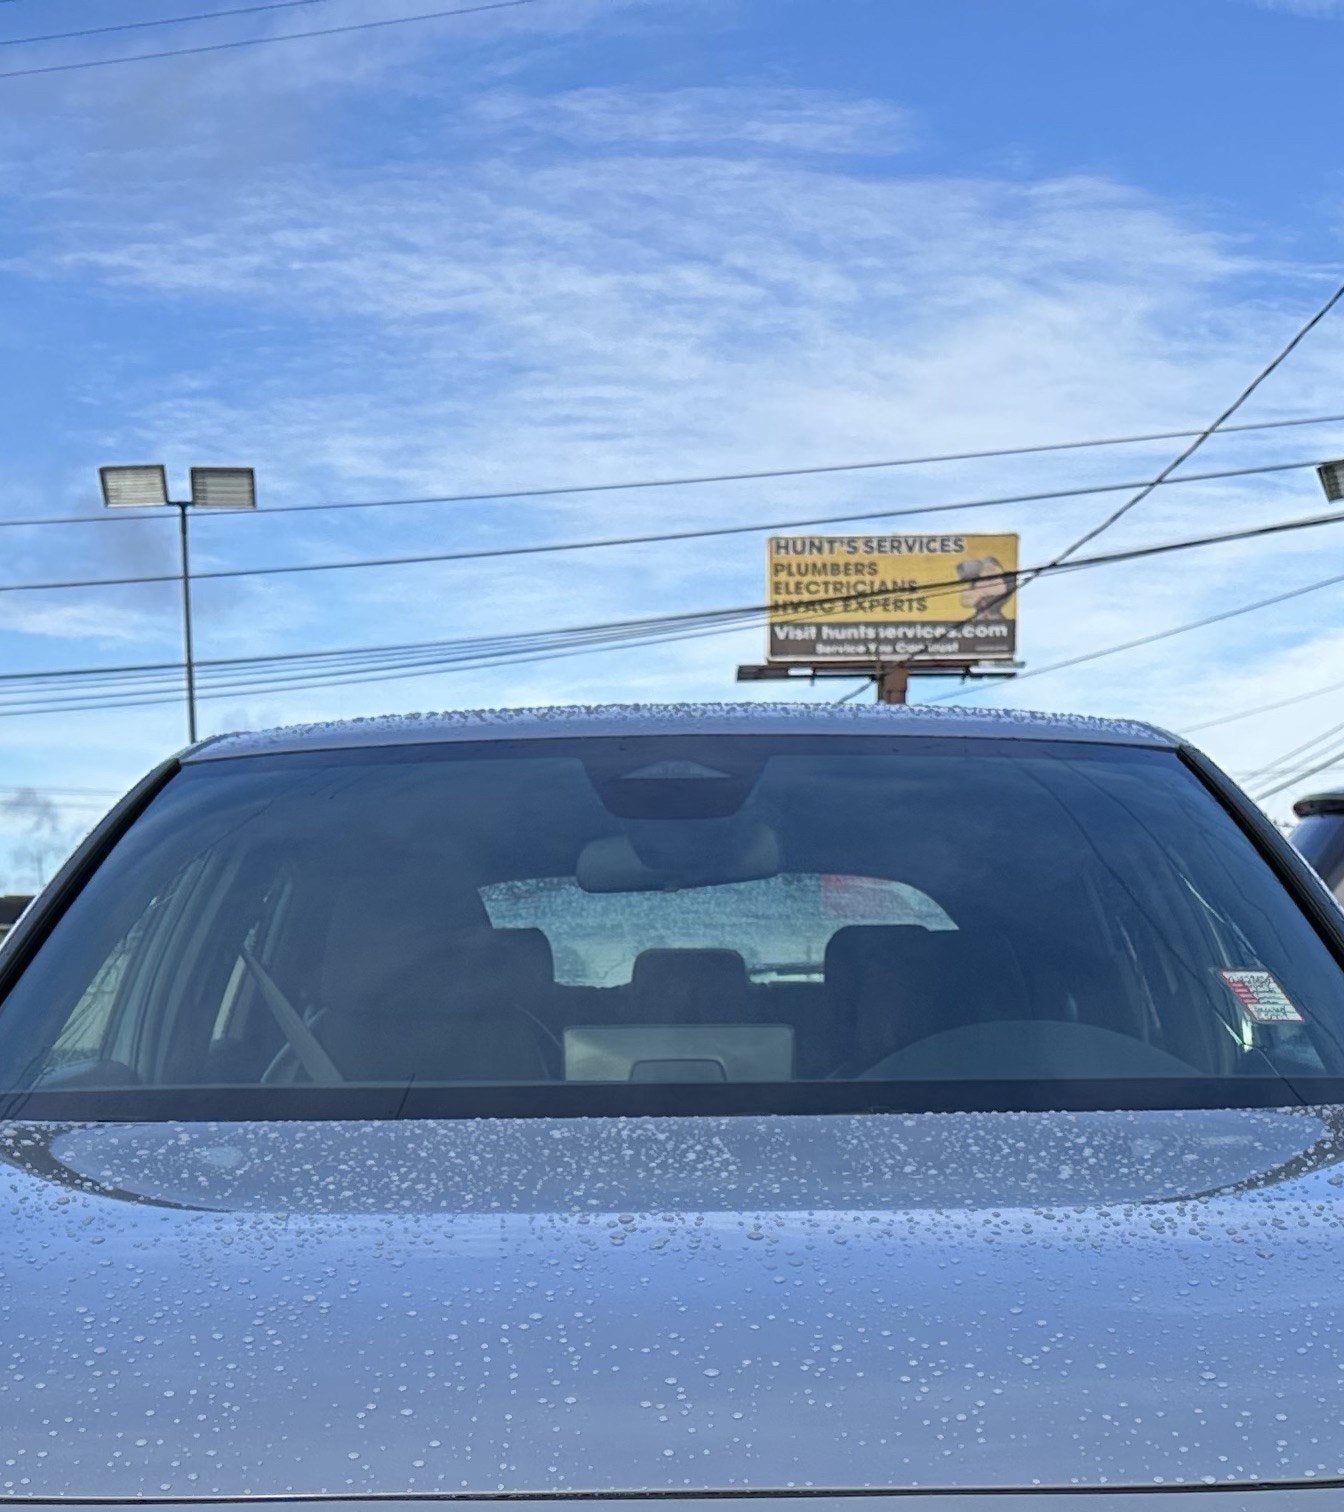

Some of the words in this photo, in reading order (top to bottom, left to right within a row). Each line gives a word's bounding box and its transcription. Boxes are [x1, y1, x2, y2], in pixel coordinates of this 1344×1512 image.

[775, 538, 859, 555] HUNT'S
[863, 536, 965, 554] SERVICES
[773, 562, 878, 577] PLUMBERS
[773, 580, 917, 595] ELECTRICIANS
[843, 597, 928, 613] EXPERTS
[774, 624, 816, 640] Visit
